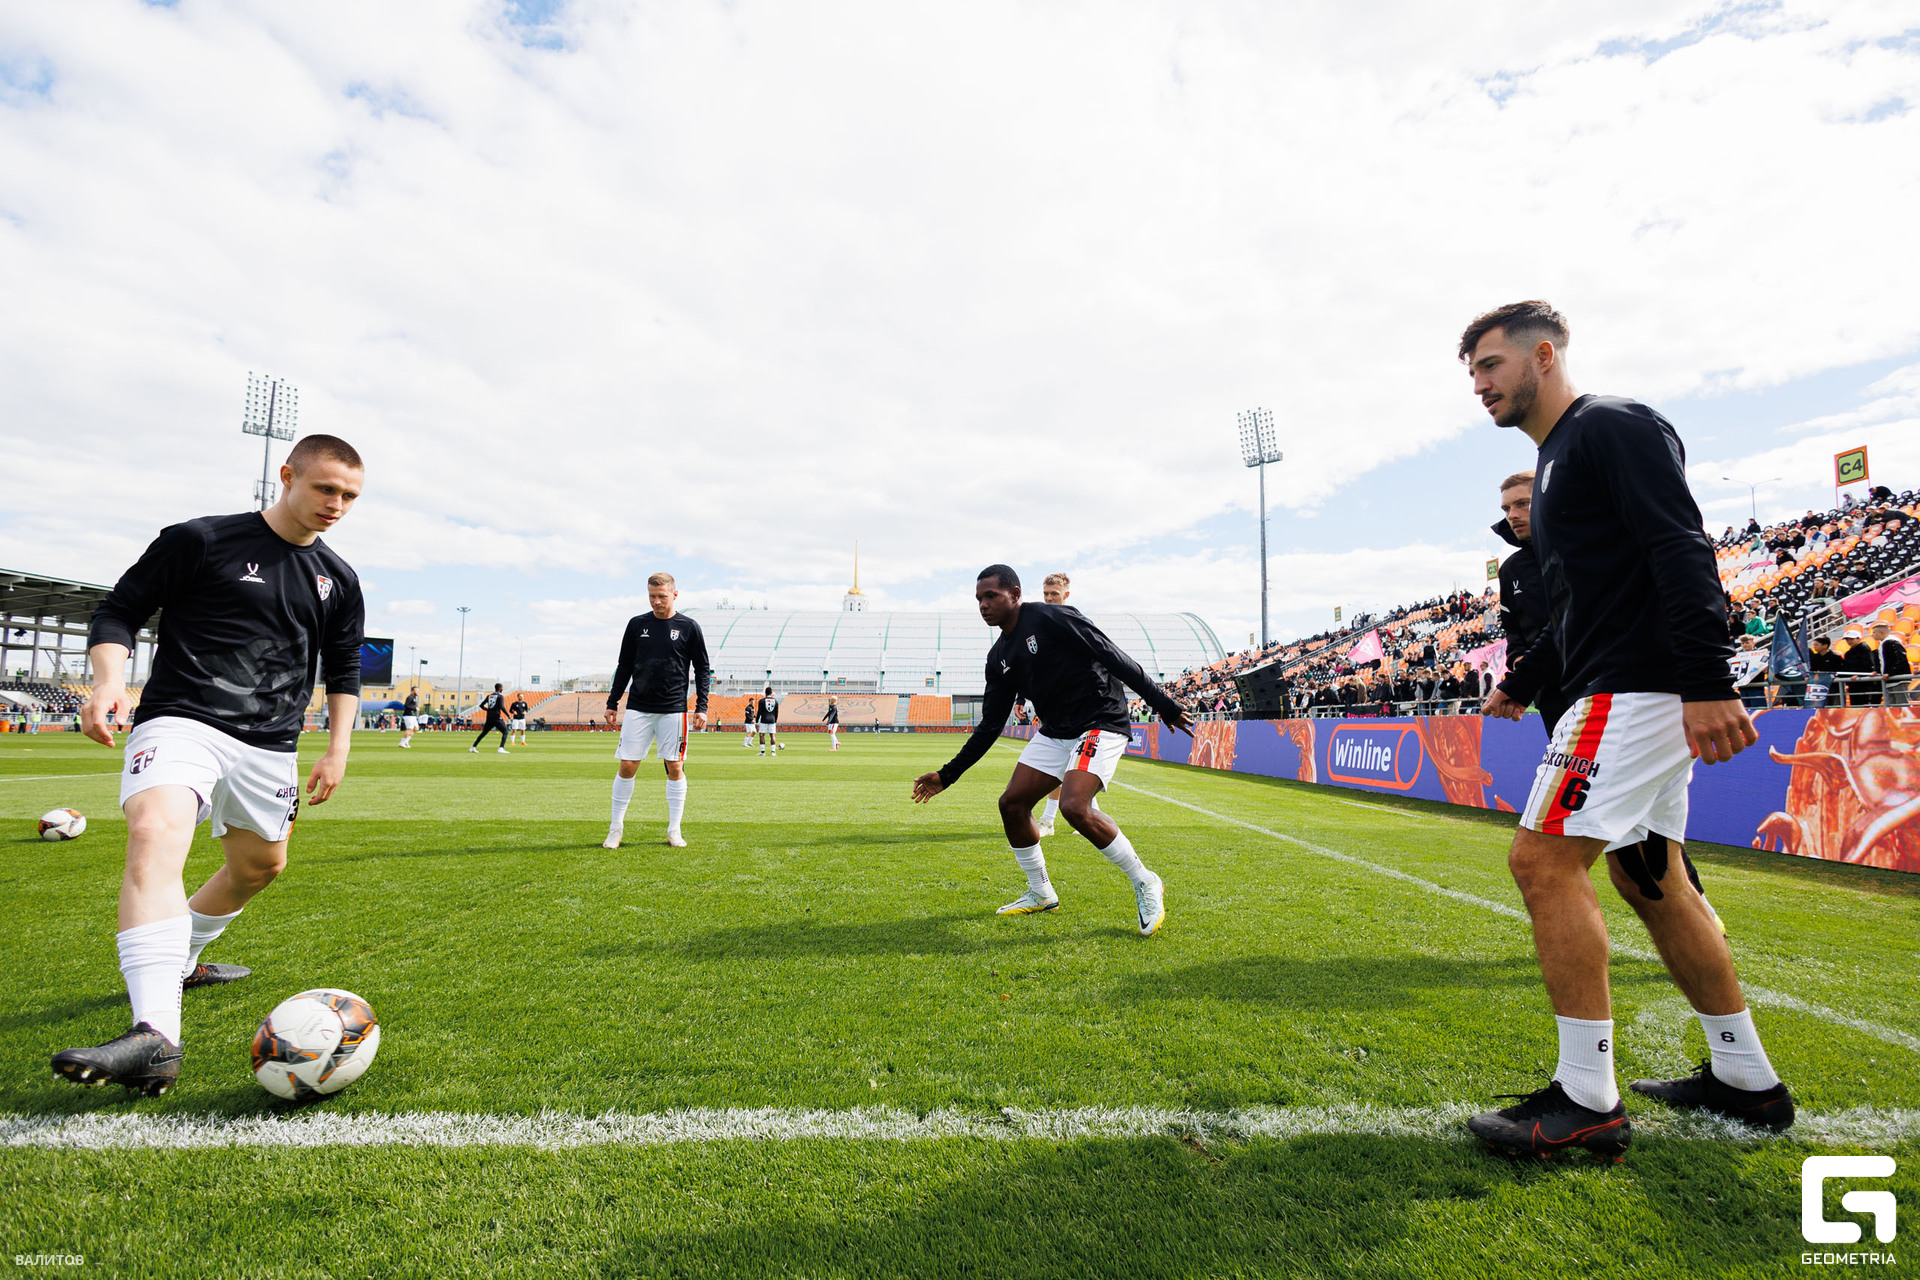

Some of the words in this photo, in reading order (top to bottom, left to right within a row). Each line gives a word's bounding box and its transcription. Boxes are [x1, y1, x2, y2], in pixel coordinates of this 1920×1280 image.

[1840, 458, 1863, 476] C4
[1488, 565, 1498, 576] C3
[1075, 741, 1098, 758] 45
[1335, 738, 1392, 772] Winline
[1560, 777, 1592, 812] 6
[287, 798, 300, 822] 3
[1721, 1031, 1736, 1043] 6
[1597, 1039, 1609, 1053] 6
